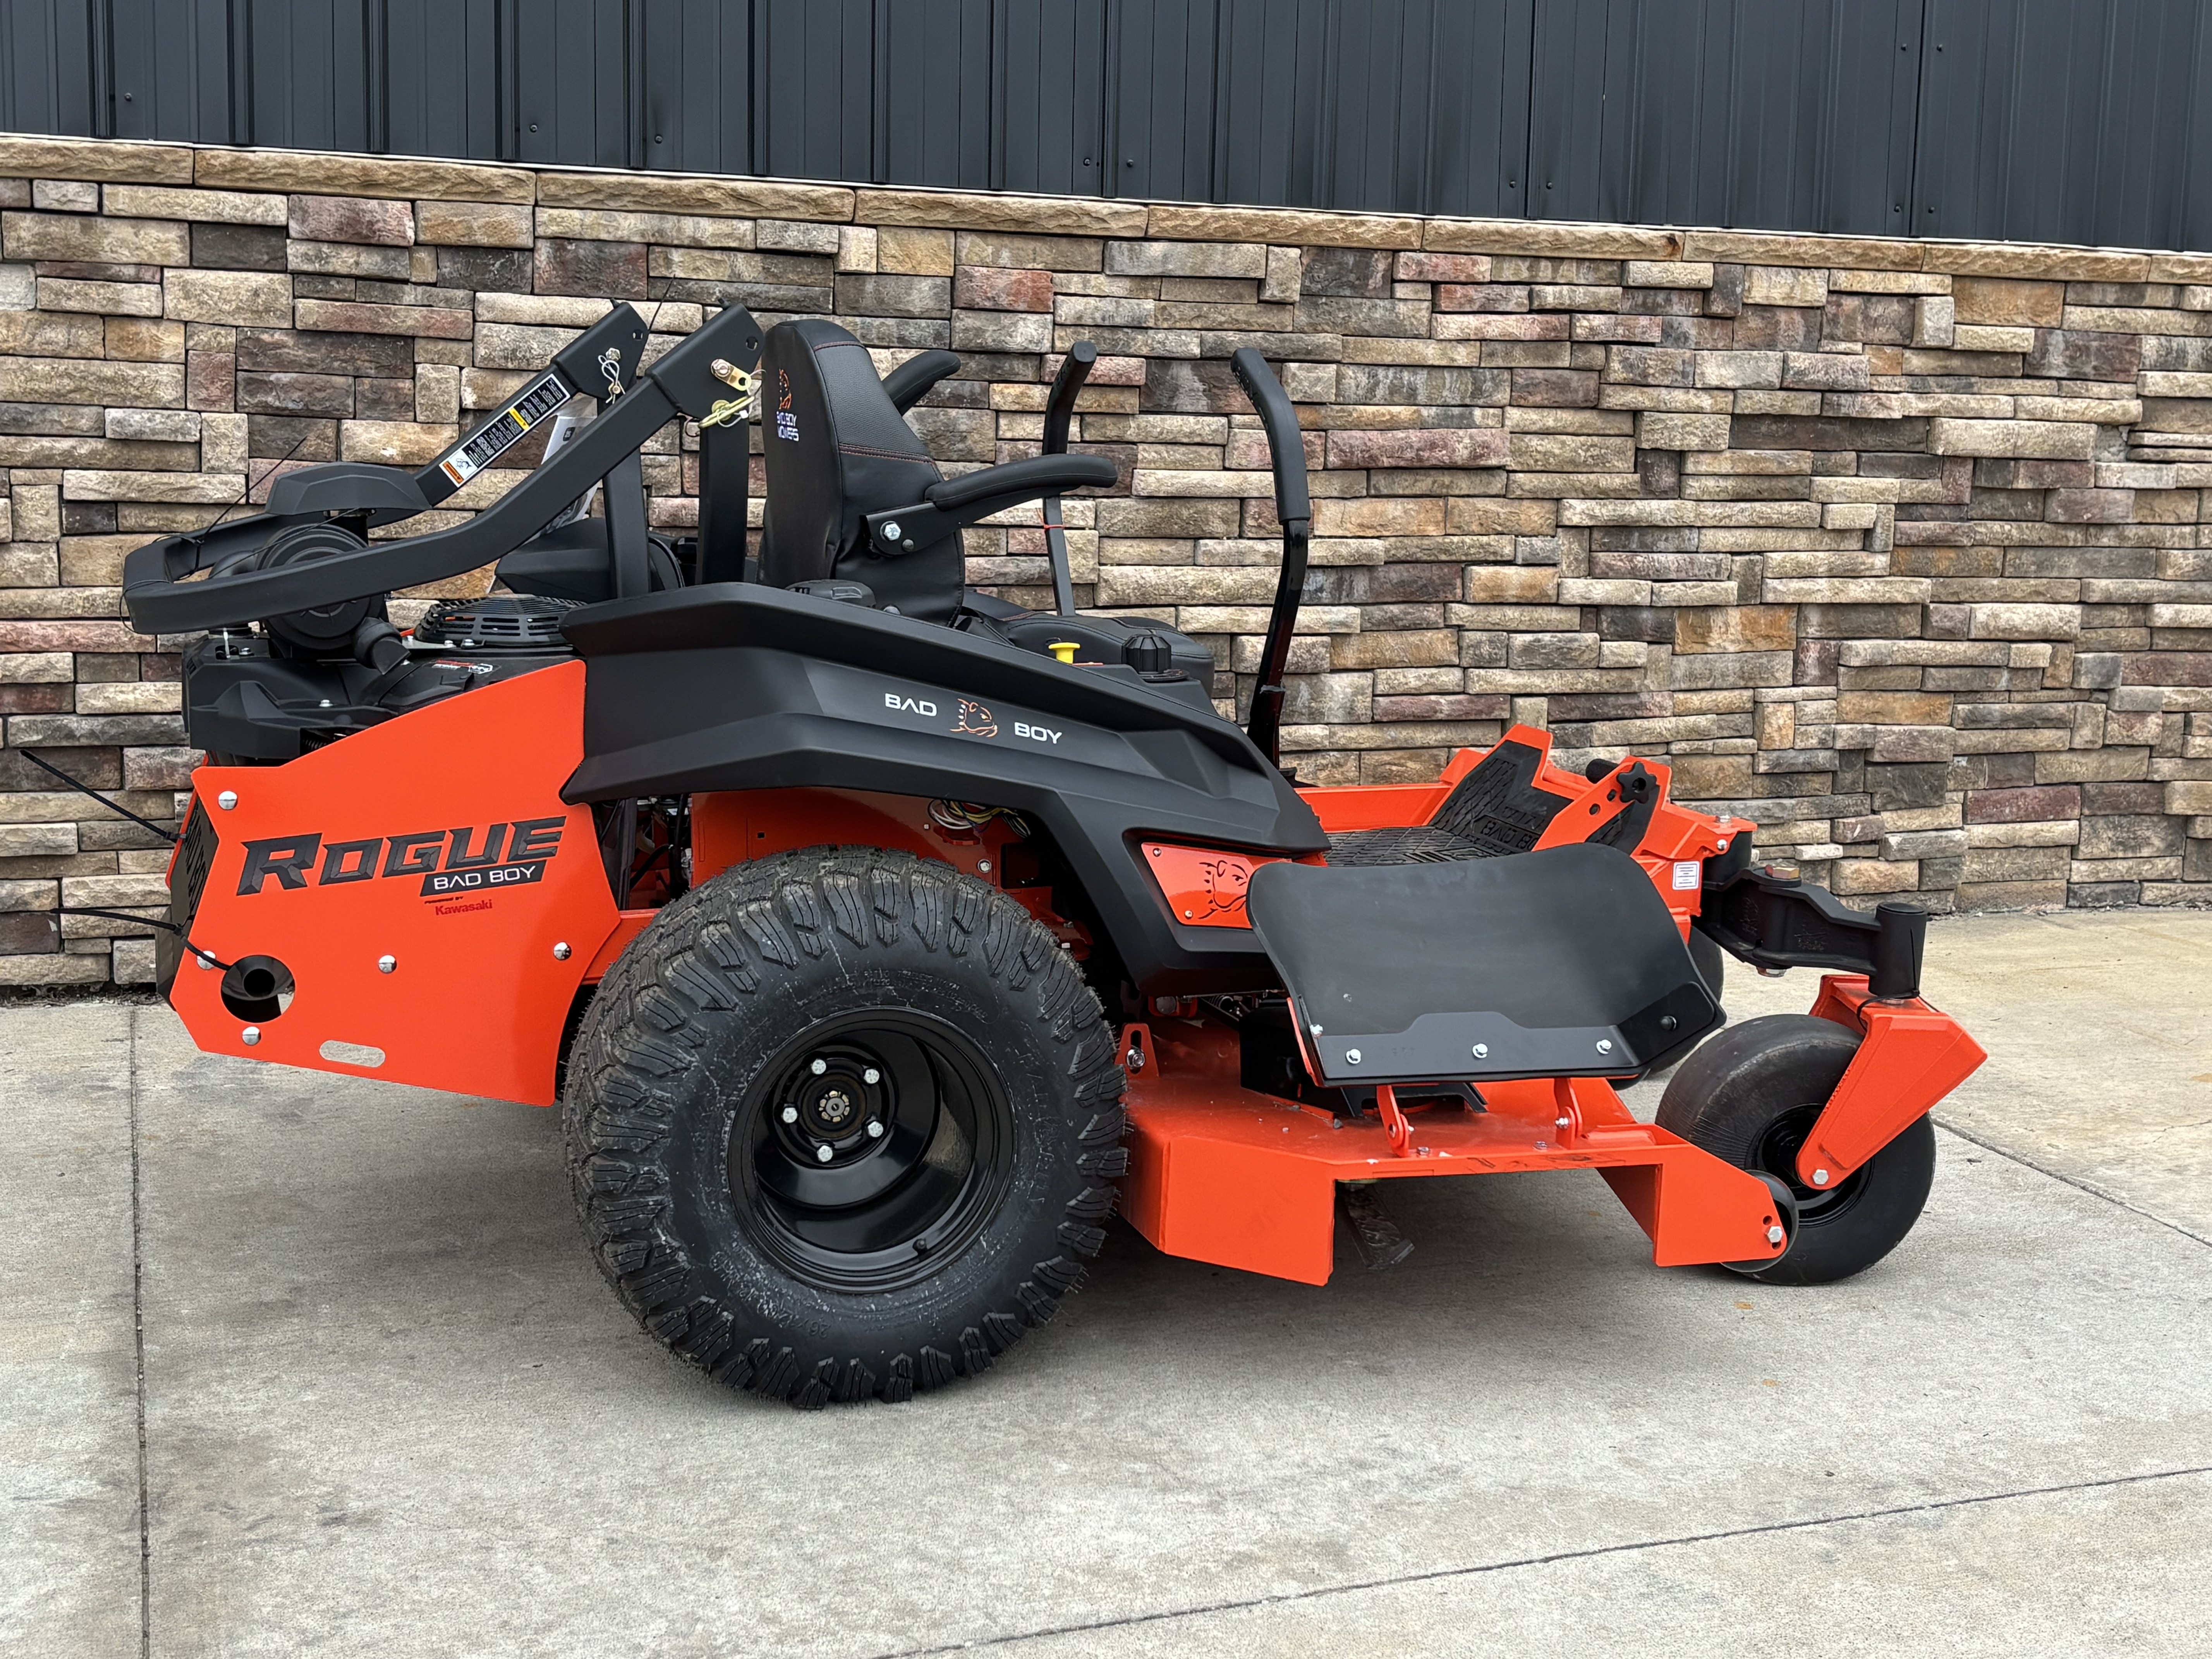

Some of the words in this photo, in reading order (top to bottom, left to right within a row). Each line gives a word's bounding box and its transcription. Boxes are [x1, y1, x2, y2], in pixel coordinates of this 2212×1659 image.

[885, 693, 937, 716] BAD
[1014, 722, 1062, 744] BOY
[236, 816, 567, 896] ROGUE
[434, 873, 481, 890] BAD
[489, 866, 536, 883] BOY
[435, 899, 493, 915] Kawasaki
